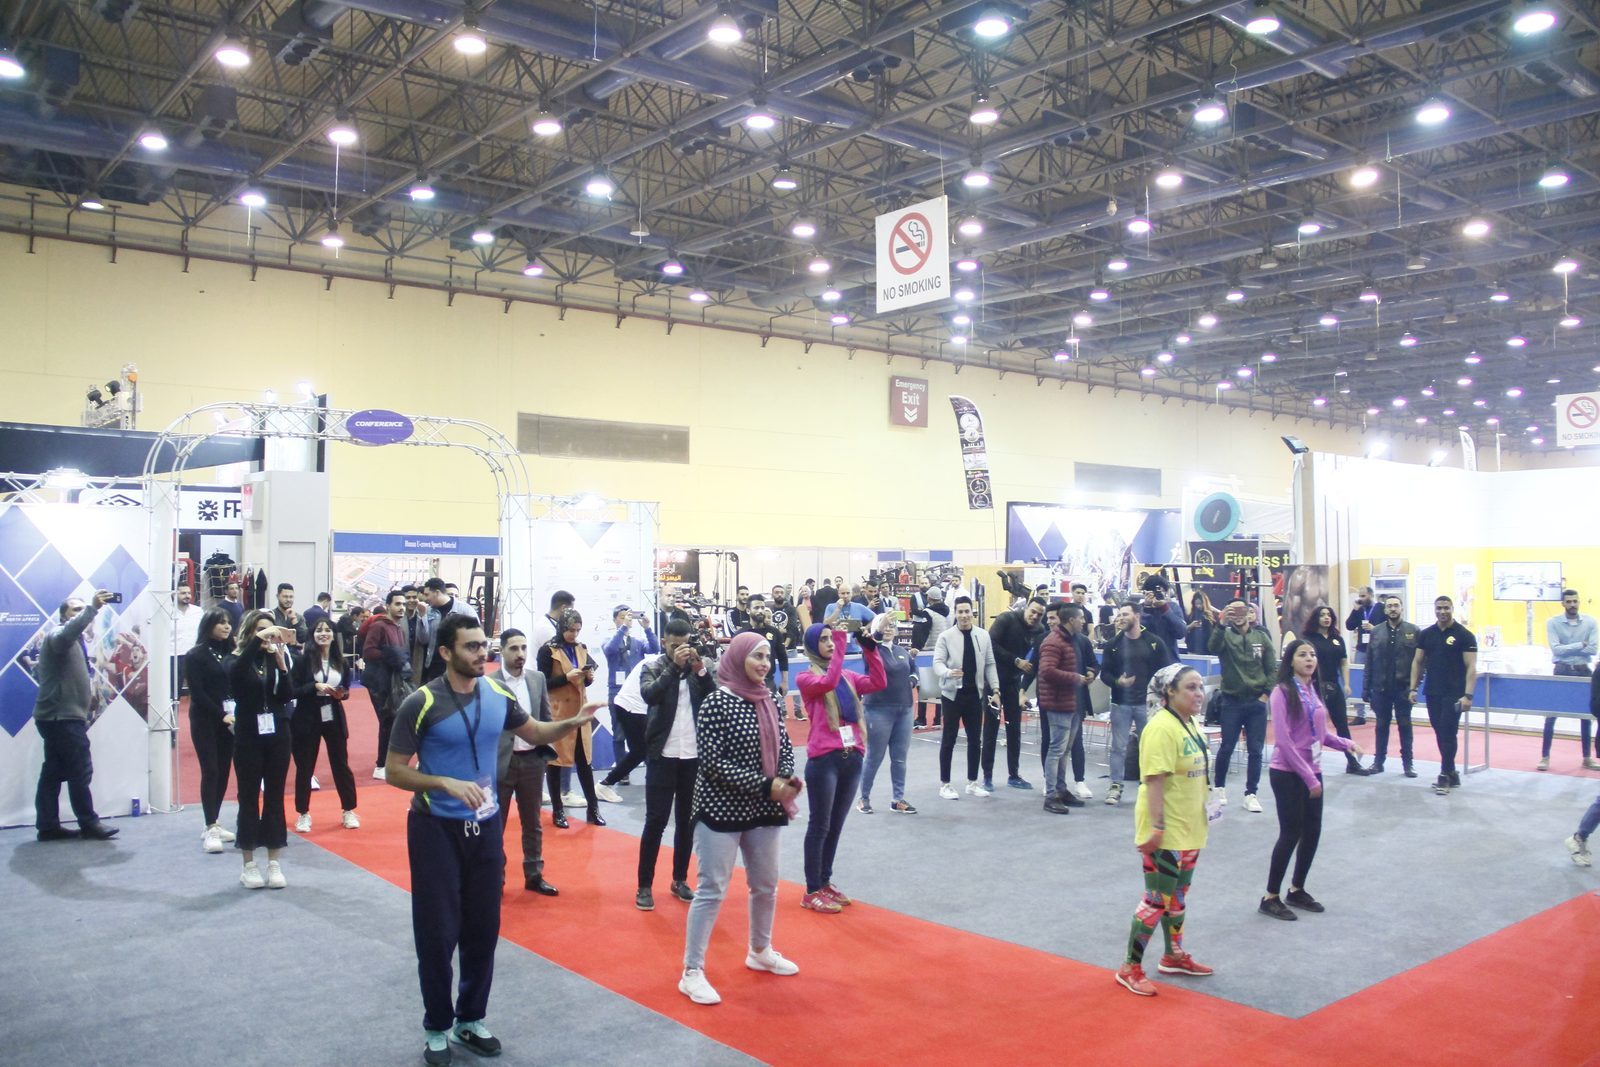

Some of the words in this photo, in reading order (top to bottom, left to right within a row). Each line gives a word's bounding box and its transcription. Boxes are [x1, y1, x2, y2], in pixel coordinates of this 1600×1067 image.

[883, 286, 896, 301] NO
[899, 275, 942, 297] SMOKING
[895, 379, 926, 392] Emergency
[902, 391, 920, 405] Exit
